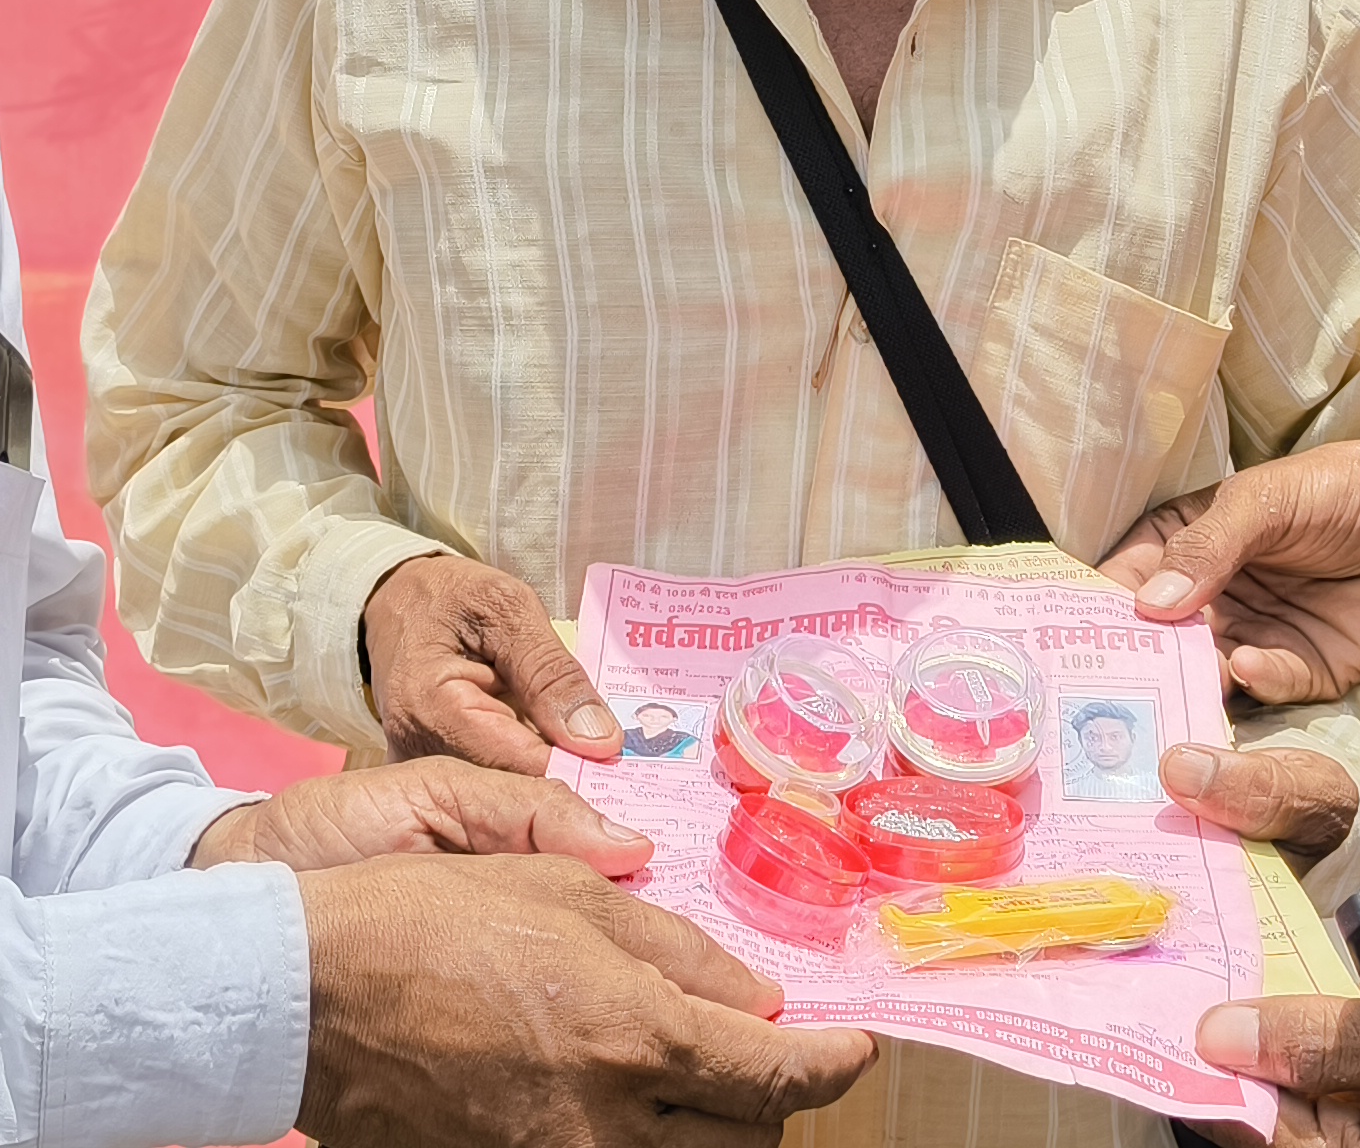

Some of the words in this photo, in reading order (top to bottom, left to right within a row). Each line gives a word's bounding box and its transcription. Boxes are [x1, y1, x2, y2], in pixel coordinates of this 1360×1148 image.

[625, 615, 784, 652] सर्वजातीय
[789, 602, 923, 647] सामूहिक
[1033, 619, 1165, 655] सम्मेलन
[1058, 653, 1106, 670] 1099
